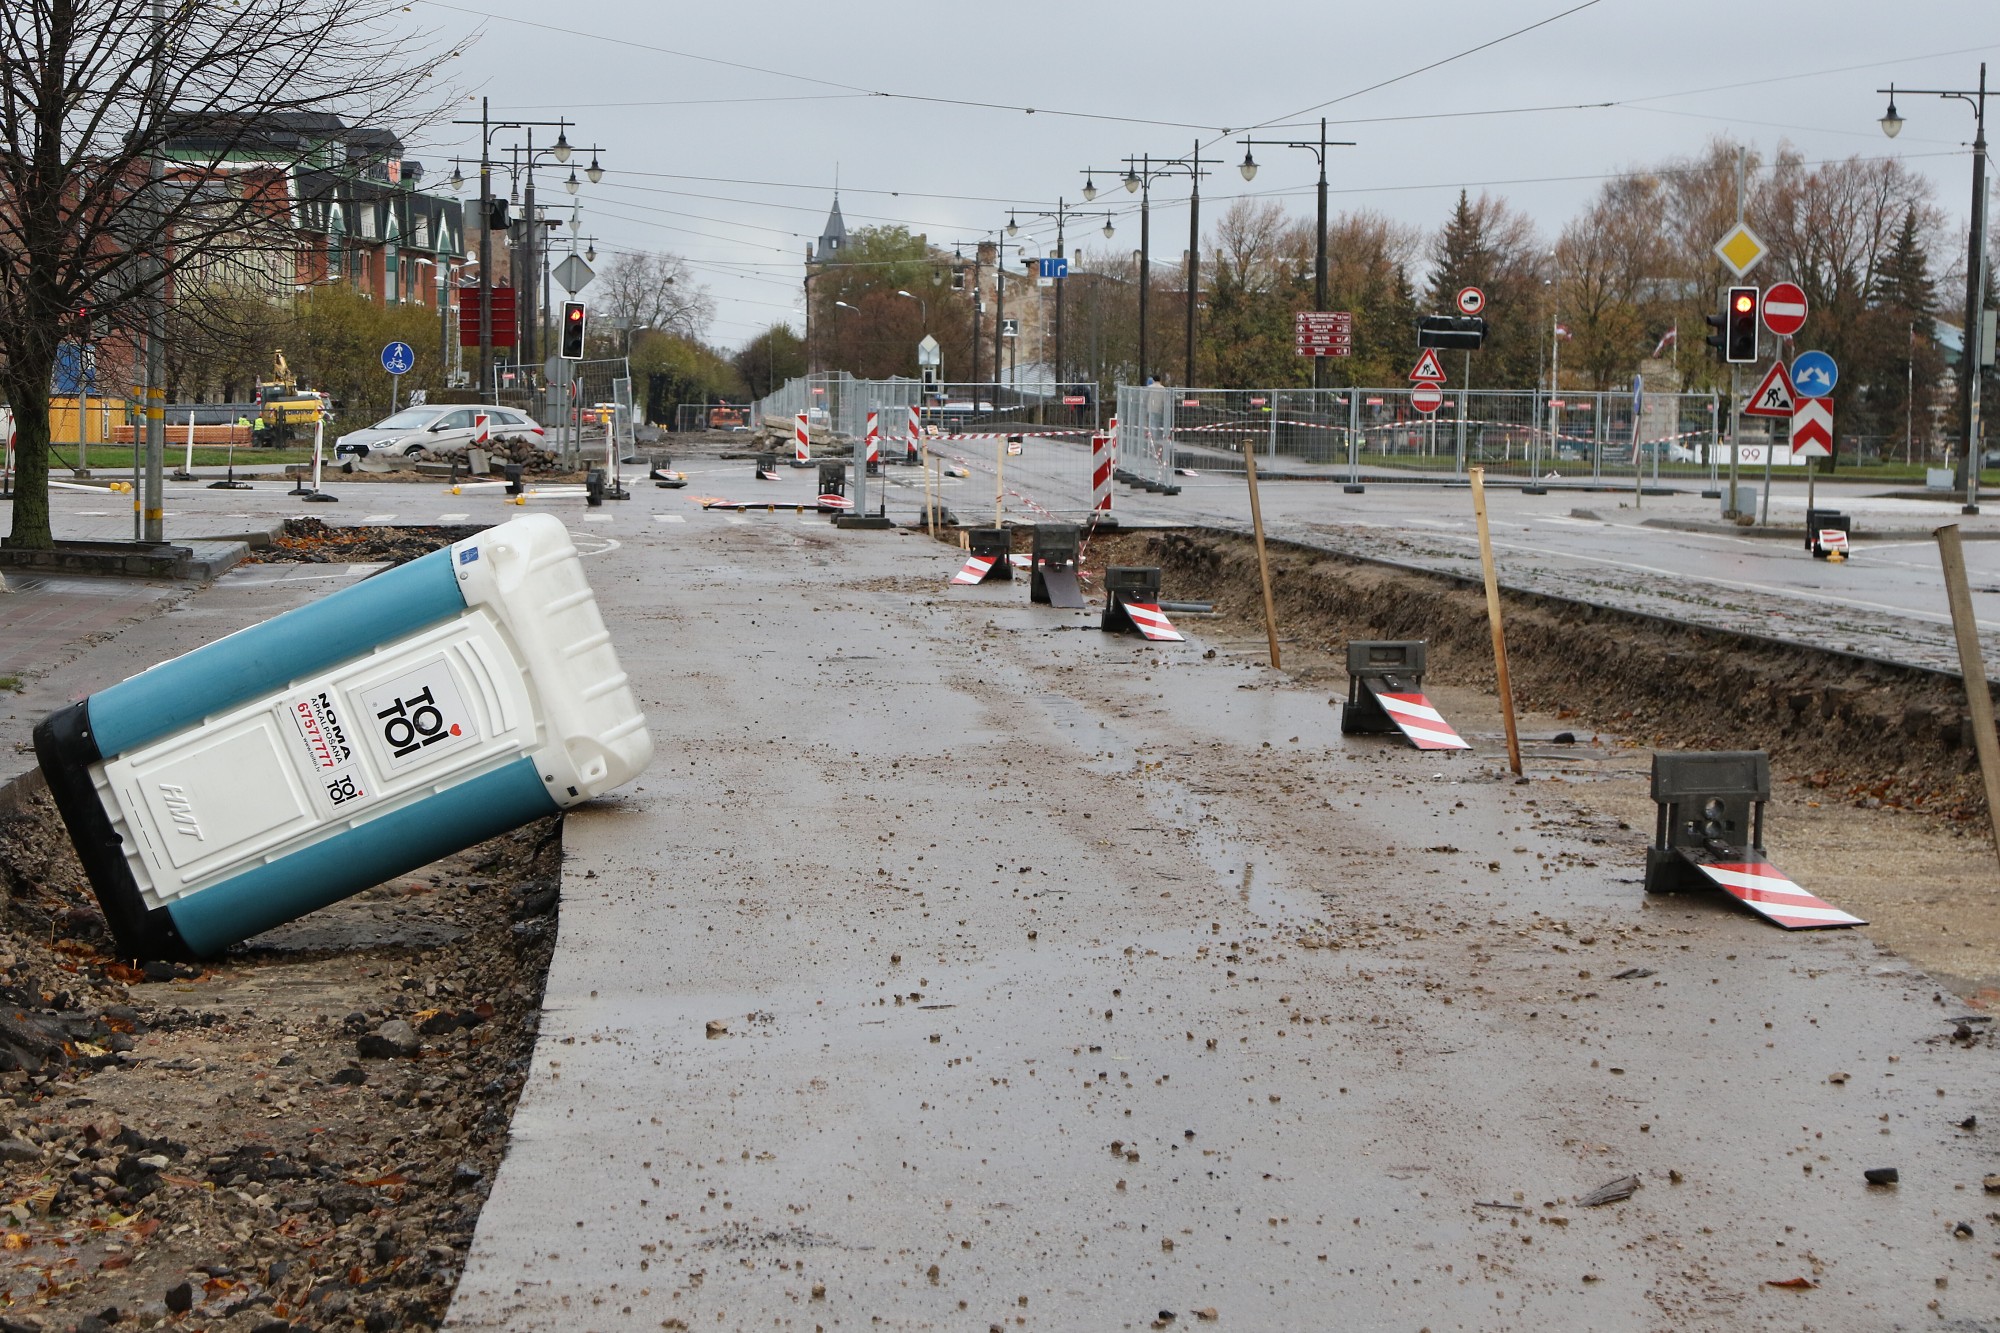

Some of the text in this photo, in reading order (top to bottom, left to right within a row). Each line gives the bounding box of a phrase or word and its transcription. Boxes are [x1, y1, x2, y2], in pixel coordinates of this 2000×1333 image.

[297, 702, 335, 768] 67577777
[310, 697, 343, 764] APKALPOŠANA
[318, 692, 351, 760] NOMA
[376, 697, 422, 759] TOI
[404, 685, 450, 747] TOI
[158, 783, 205, 842] HMT
[326, 779, 346, 806] TOI
[338, 774, 358, 801] TOI
